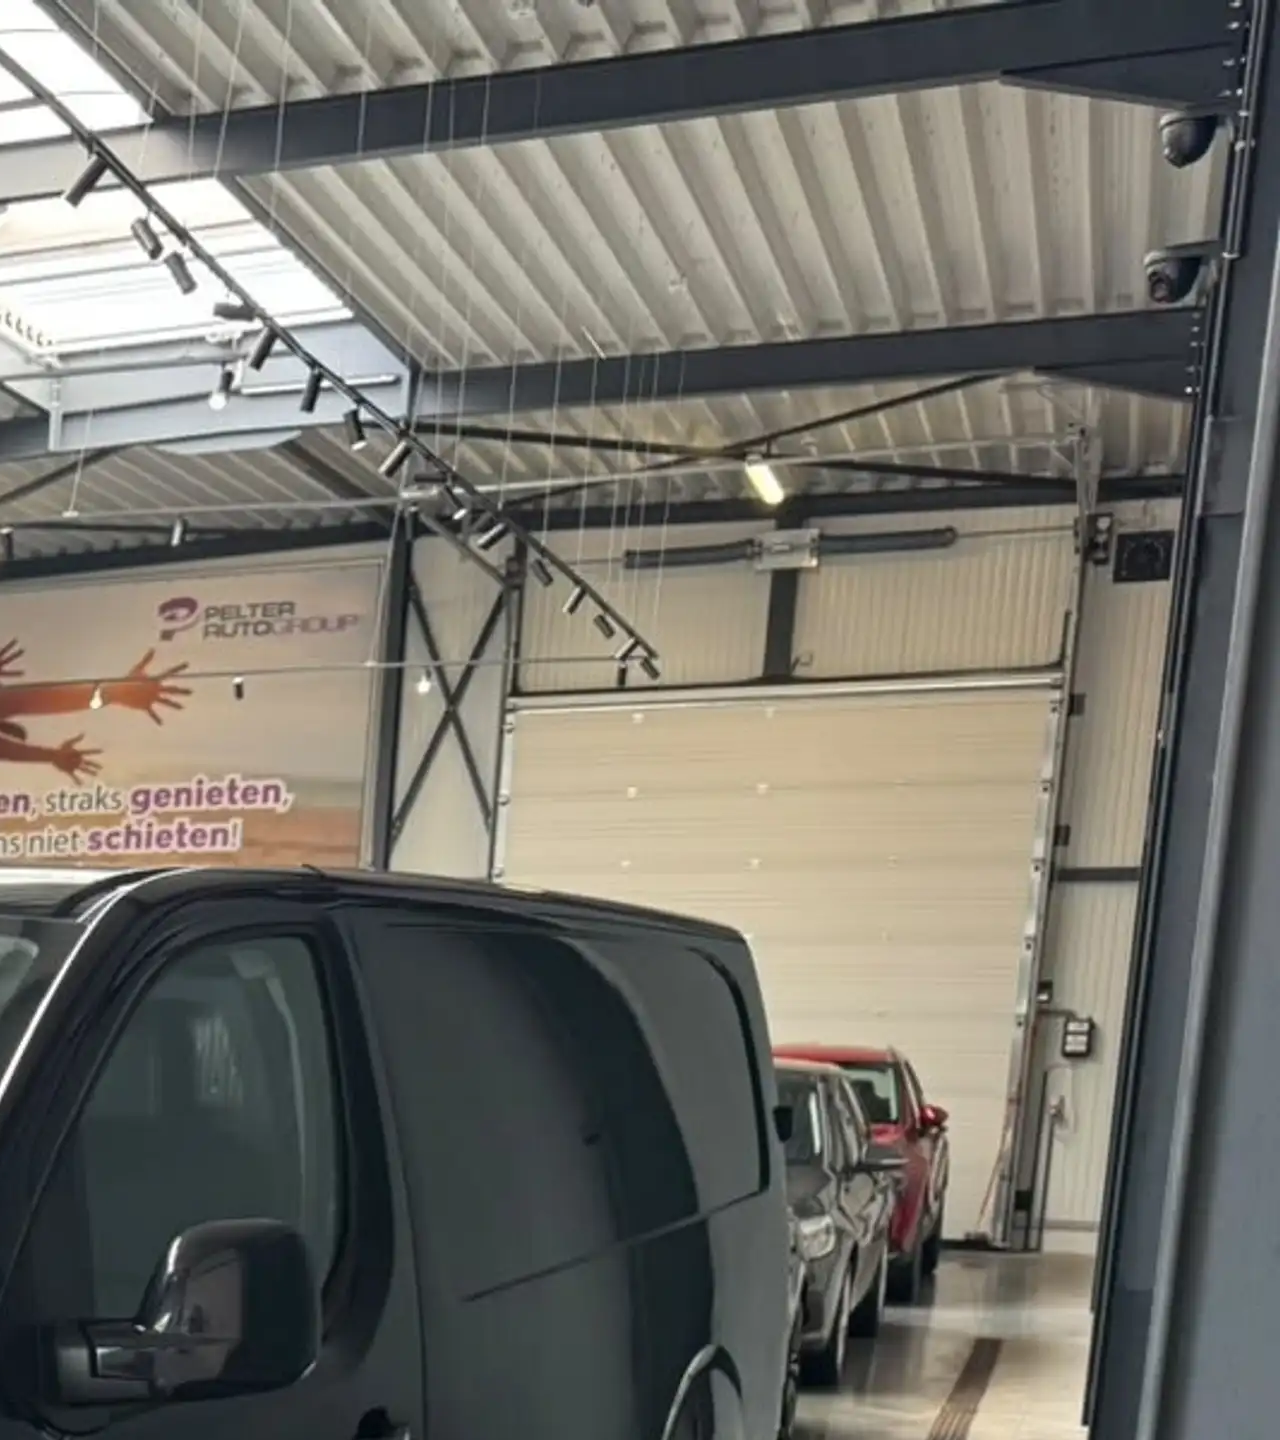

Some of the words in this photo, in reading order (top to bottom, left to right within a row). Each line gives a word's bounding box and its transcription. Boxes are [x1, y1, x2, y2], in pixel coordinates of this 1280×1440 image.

[204, 601, 296, 621] PELTER
[203, 613, 359, 640] AUTOGROUP
[46, 785, 122, 812] straks
[130, 778, 290, 814] genieten,
[29, 827, 80, 852] niet
[87, 818, 239, 851] schieten!
